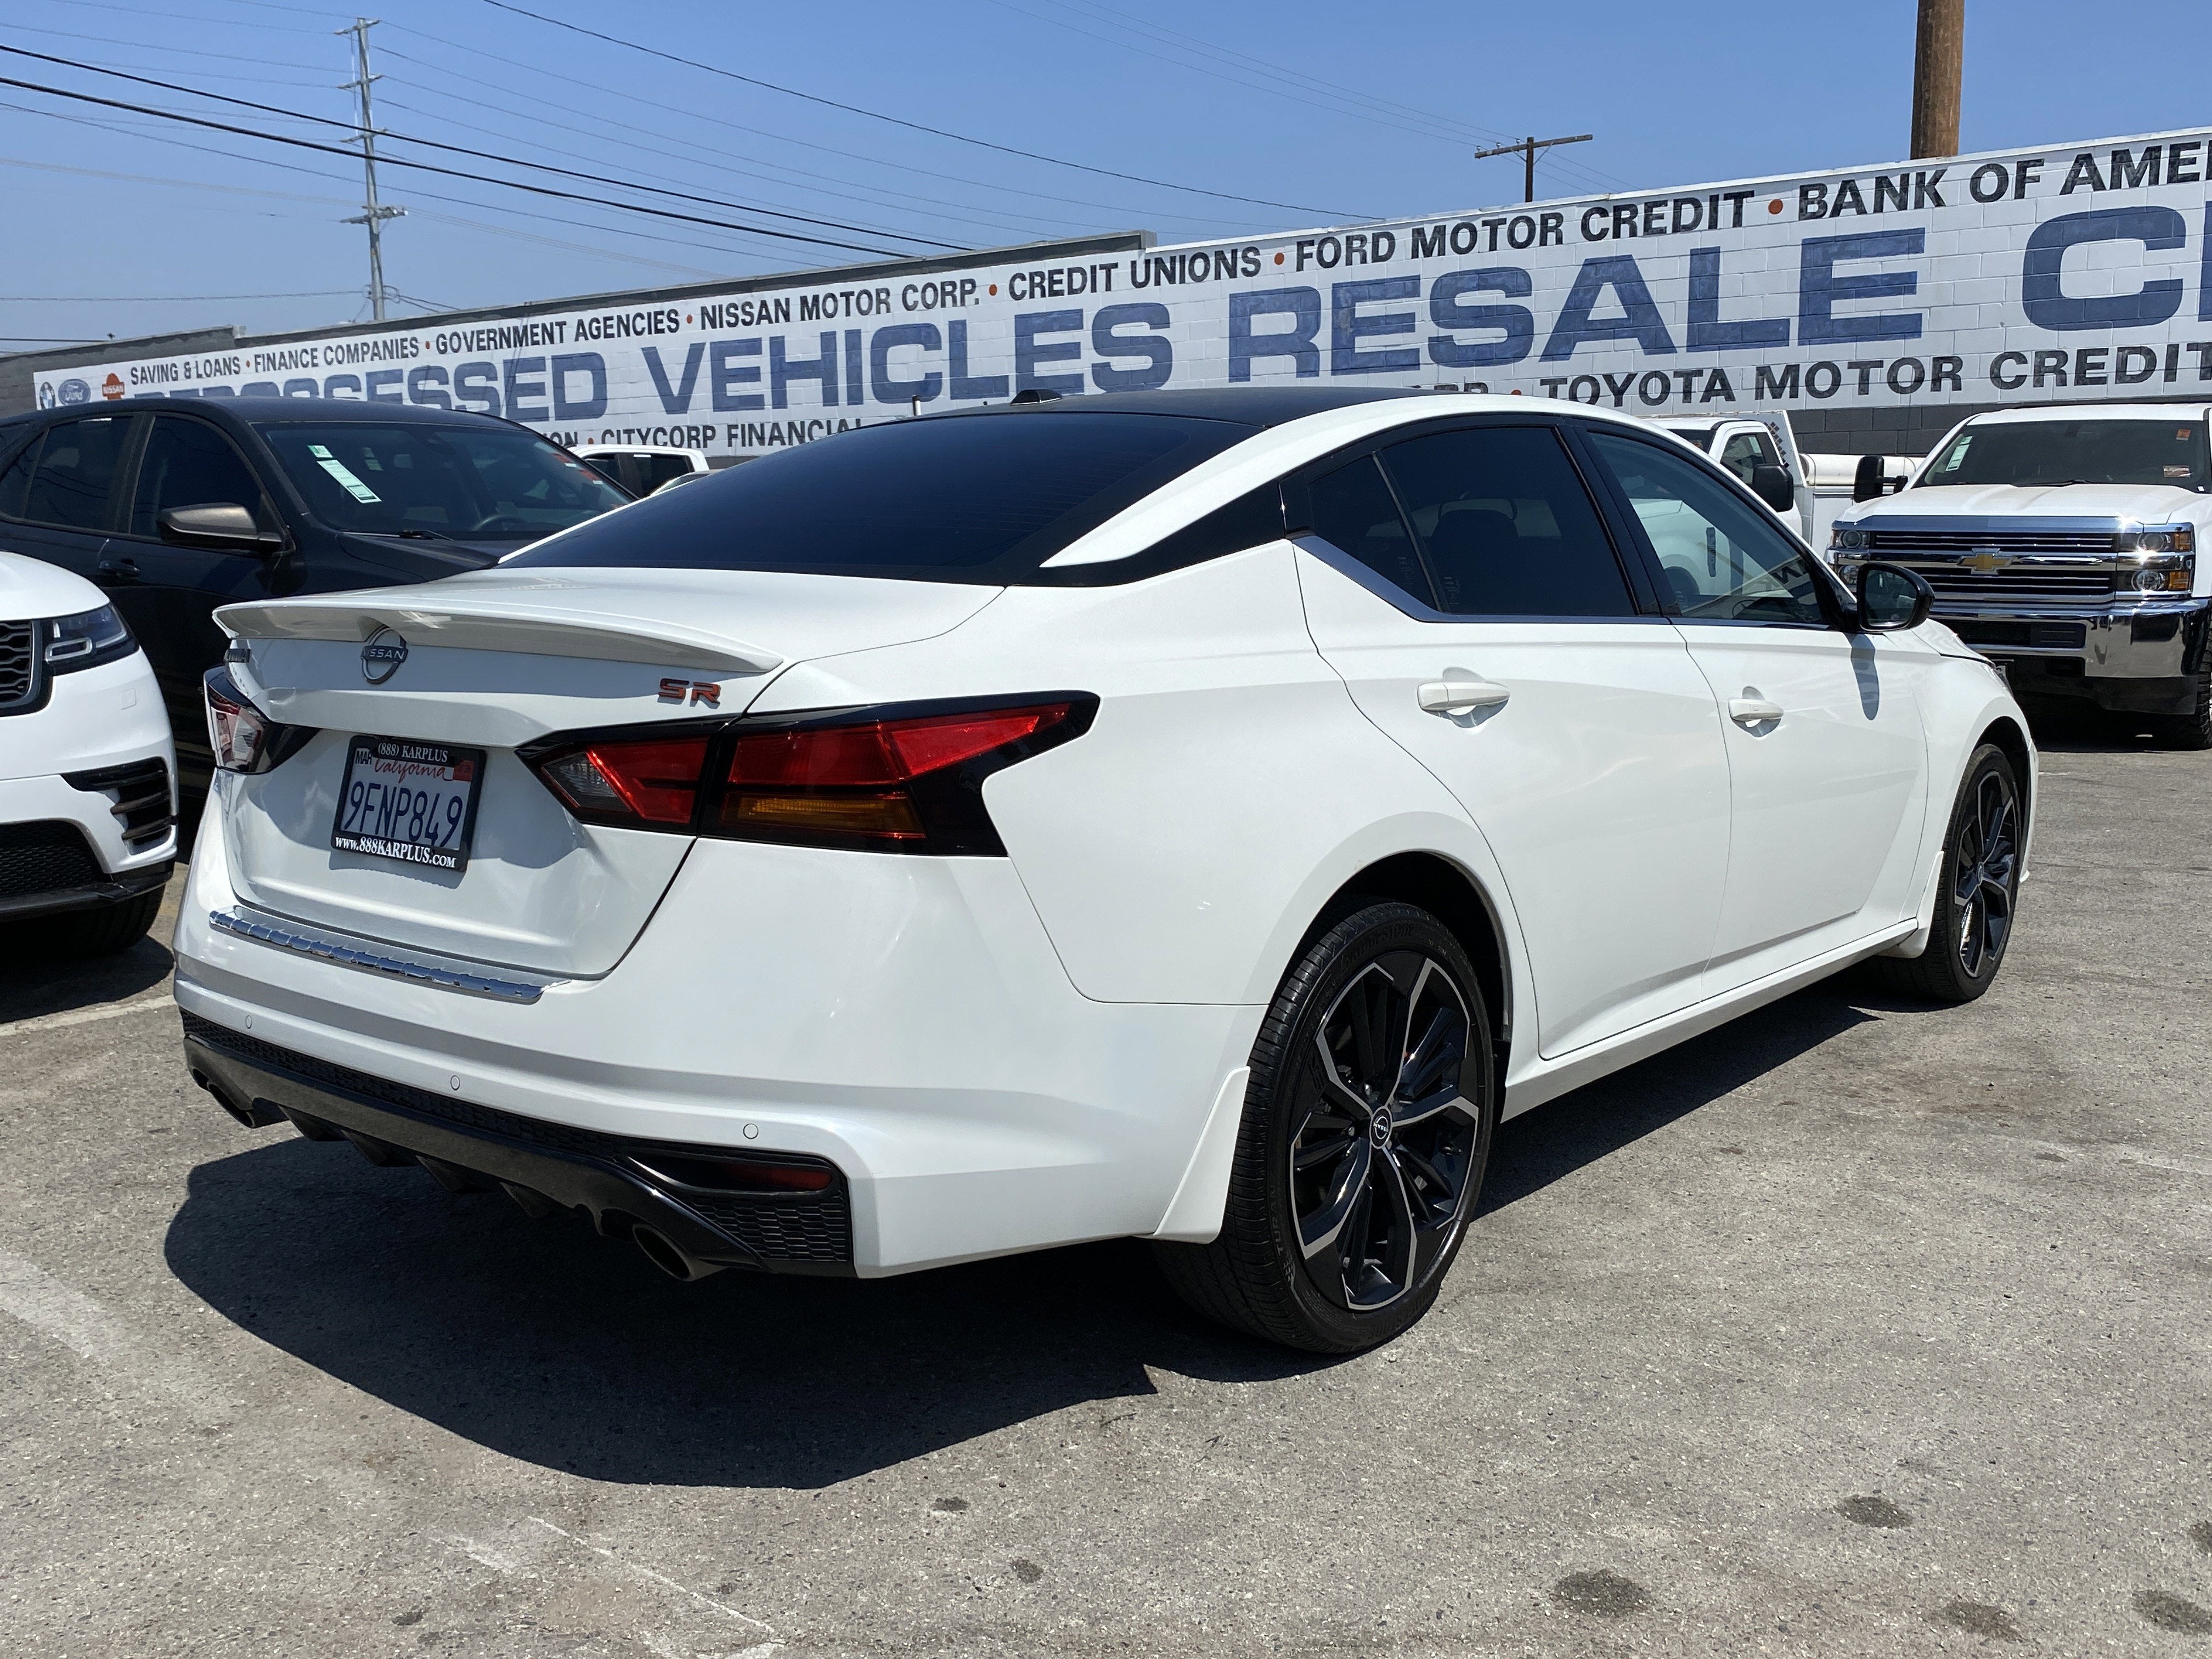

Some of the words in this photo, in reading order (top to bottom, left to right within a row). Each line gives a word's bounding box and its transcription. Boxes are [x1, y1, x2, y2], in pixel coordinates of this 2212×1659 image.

[1798, 168, 1948, 221] BANK
[1970, 159, 2045, 203] OF
[1296, 231, 1396, 272] FORD
[1411, 212, 1564, 259] MOTOR
[1581, 190, 1754, 241] CREDIT
[1009, 262, 1118, 301] CREDIT
[1131, 246, 1261, 289] UNIONS
[641, 302, 1173, 415] VEHICLES
[1229, 227, 1926, 383] RESALE
[2022, 201, 2212, 331] C
[701, 297, 790, 329] NISSAN
[799, 287, 891, 321] MOTOR
[901, 278, 979, 312] CORP.
[254, 348, 318, 373] FINANCE
[324, 336, 419, 365] COMPANIES
[436, 321, 567, 354] GOVERNMENT
[574, 309, 680, 342] AGENCIES
[131, 363, 178, 385] SAVING
[184, 362, 191, 379] &
[195, 356, 241, 379] LOANS
[1540, 368, 1736, 407] TOYOTA
[1754, 356, 1963, 400] MOTOR
[1989, 342, 2212, 390] CREDIT
[601, 426, 716, 448] CITYCORP
[658, 678, 721, 704] SR
[374, 758, 453, 783] California
[379, 743, 399, 757] (888)
[402, 746, 448, 763] KARPLUS
[344, 781, 463, 847] 9FNP849
